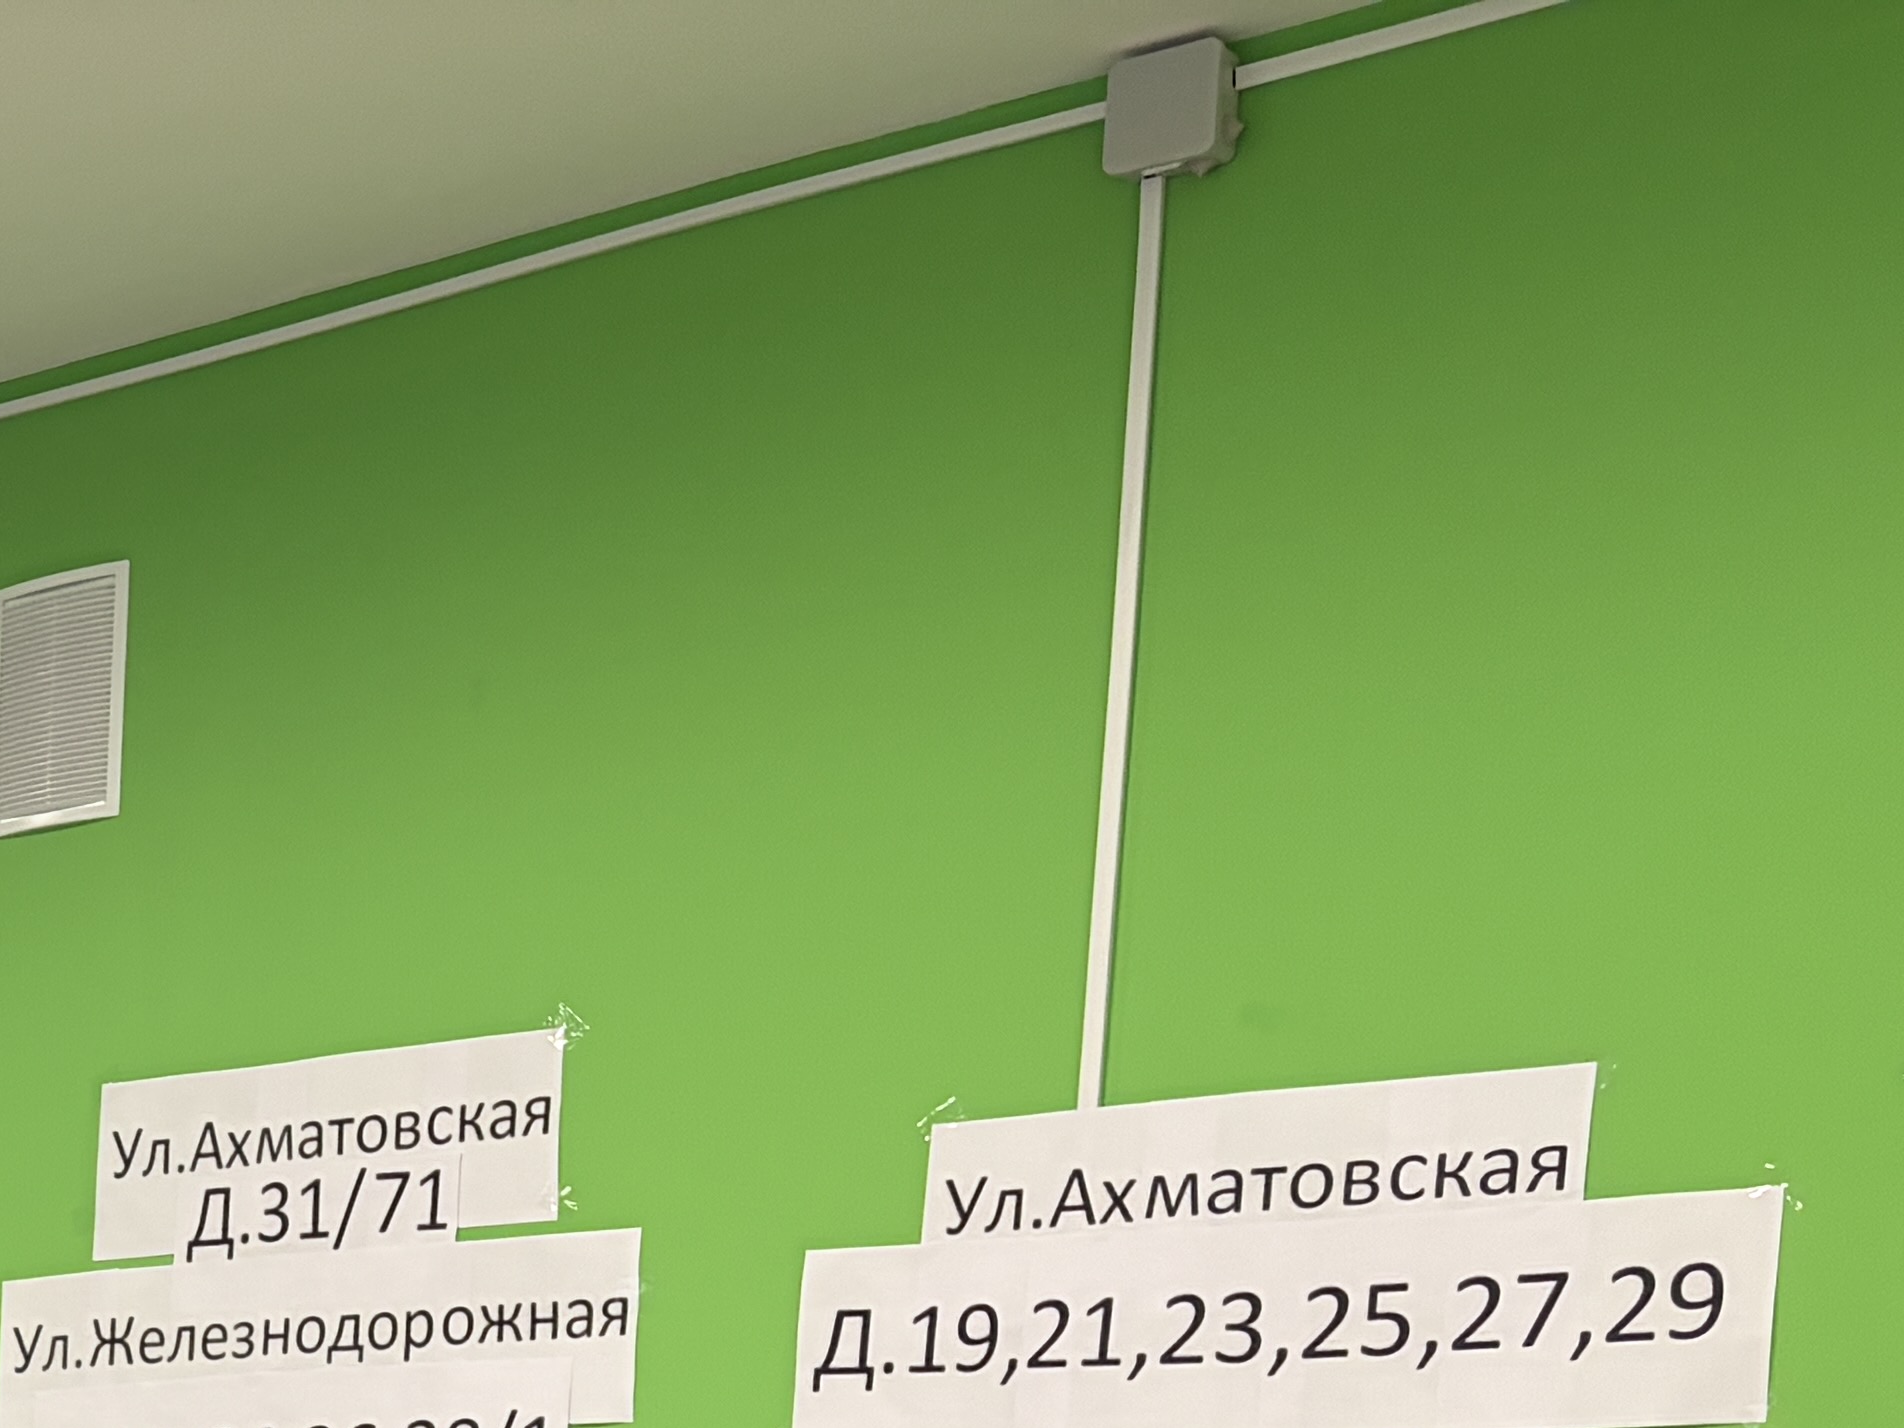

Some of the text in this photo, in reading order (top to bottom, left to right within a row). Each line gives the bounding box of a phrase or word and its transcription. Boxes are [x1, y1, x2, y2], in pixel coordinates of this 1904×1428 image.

[112, 1095, 552, 1179] Ул.Ахматовская
[185, 1167, 449, 1263] Д.31/71
[944, 1143, 1569, 1236] Ул.Ахматовская
[12, 1295, 630, 1375] Ул.Железнодорожная
[812, 1259, 1726, 1393] Д.19,21,23,25,27,29
